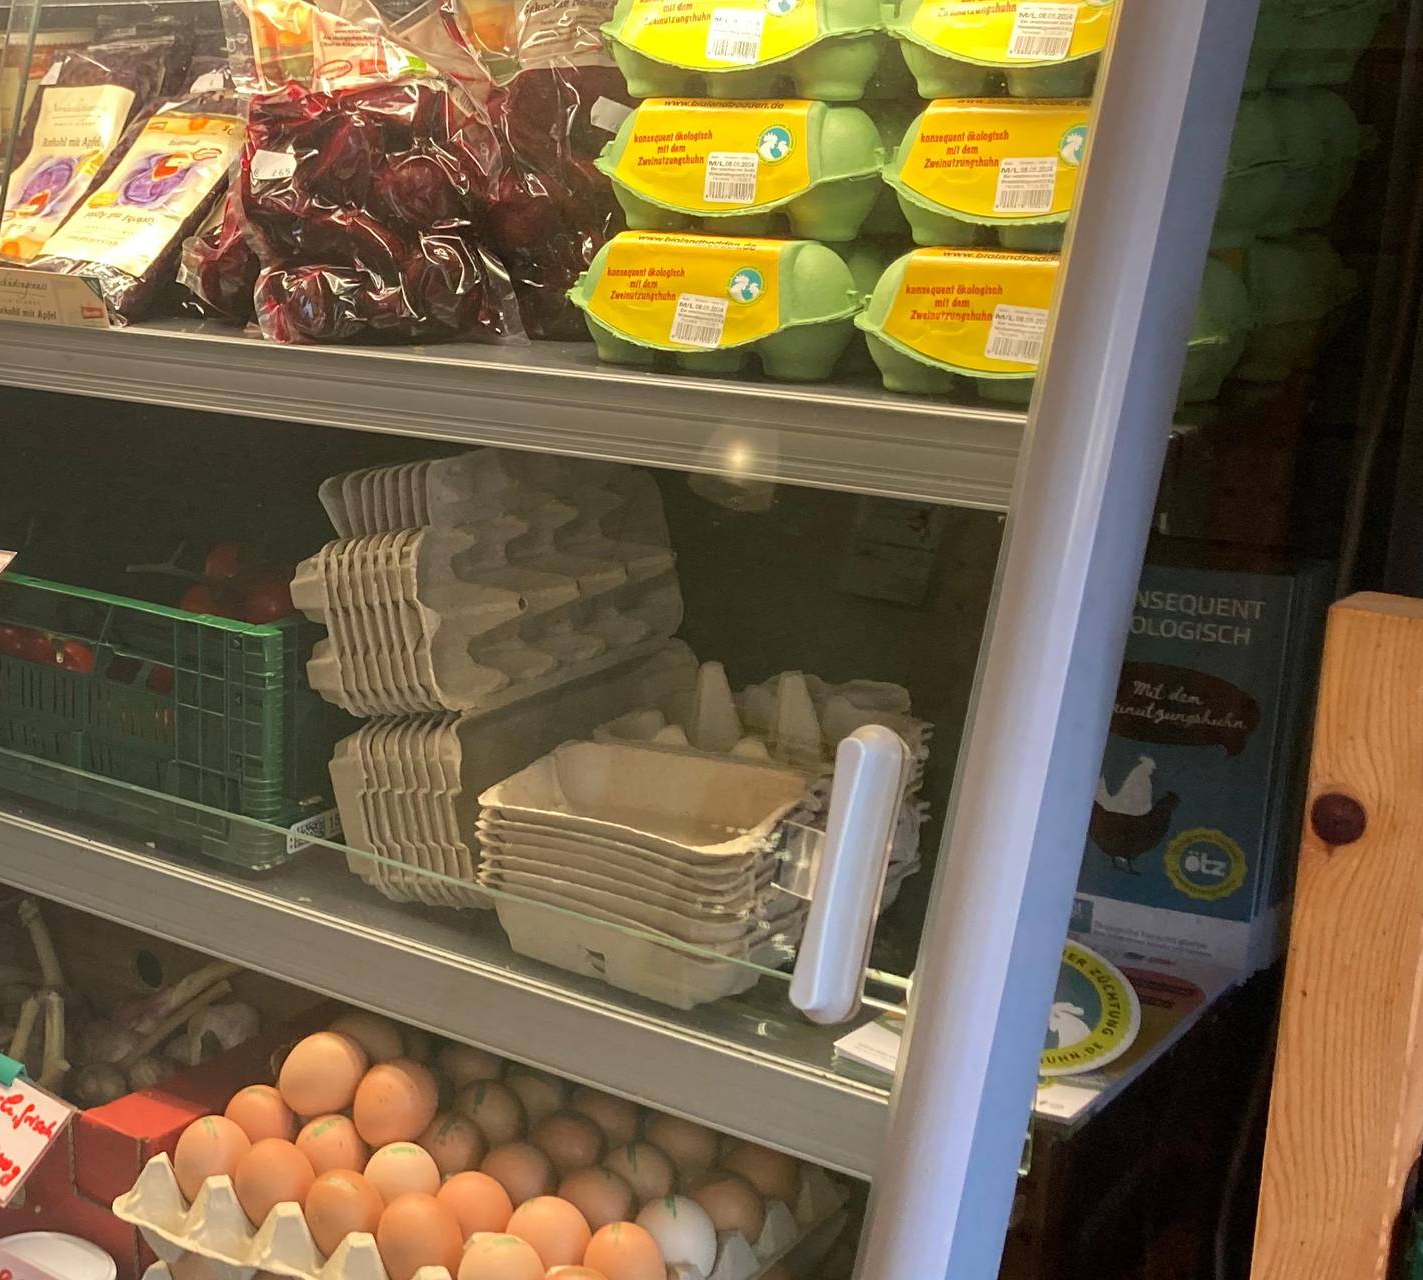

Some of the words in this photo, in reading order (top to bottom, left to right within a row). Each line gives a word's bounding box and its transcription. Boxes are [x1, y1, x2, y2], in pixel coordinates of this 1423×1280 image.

[657, 143, 669, 154] mit
[670, 143, 686, 153] dem
[946, 145, 960, 155] mit
[961, 145, 979, 155] dem
[629, 279, 642, 289] mit
[643, 279, 658, 289] dem
[934, 297, 950, 308] mit
[951, 298, 970, 308] dem
[1134, 589, 1267, 622] NSEQUENT
[1130, 616, 1252, 646] OLOGISCH
